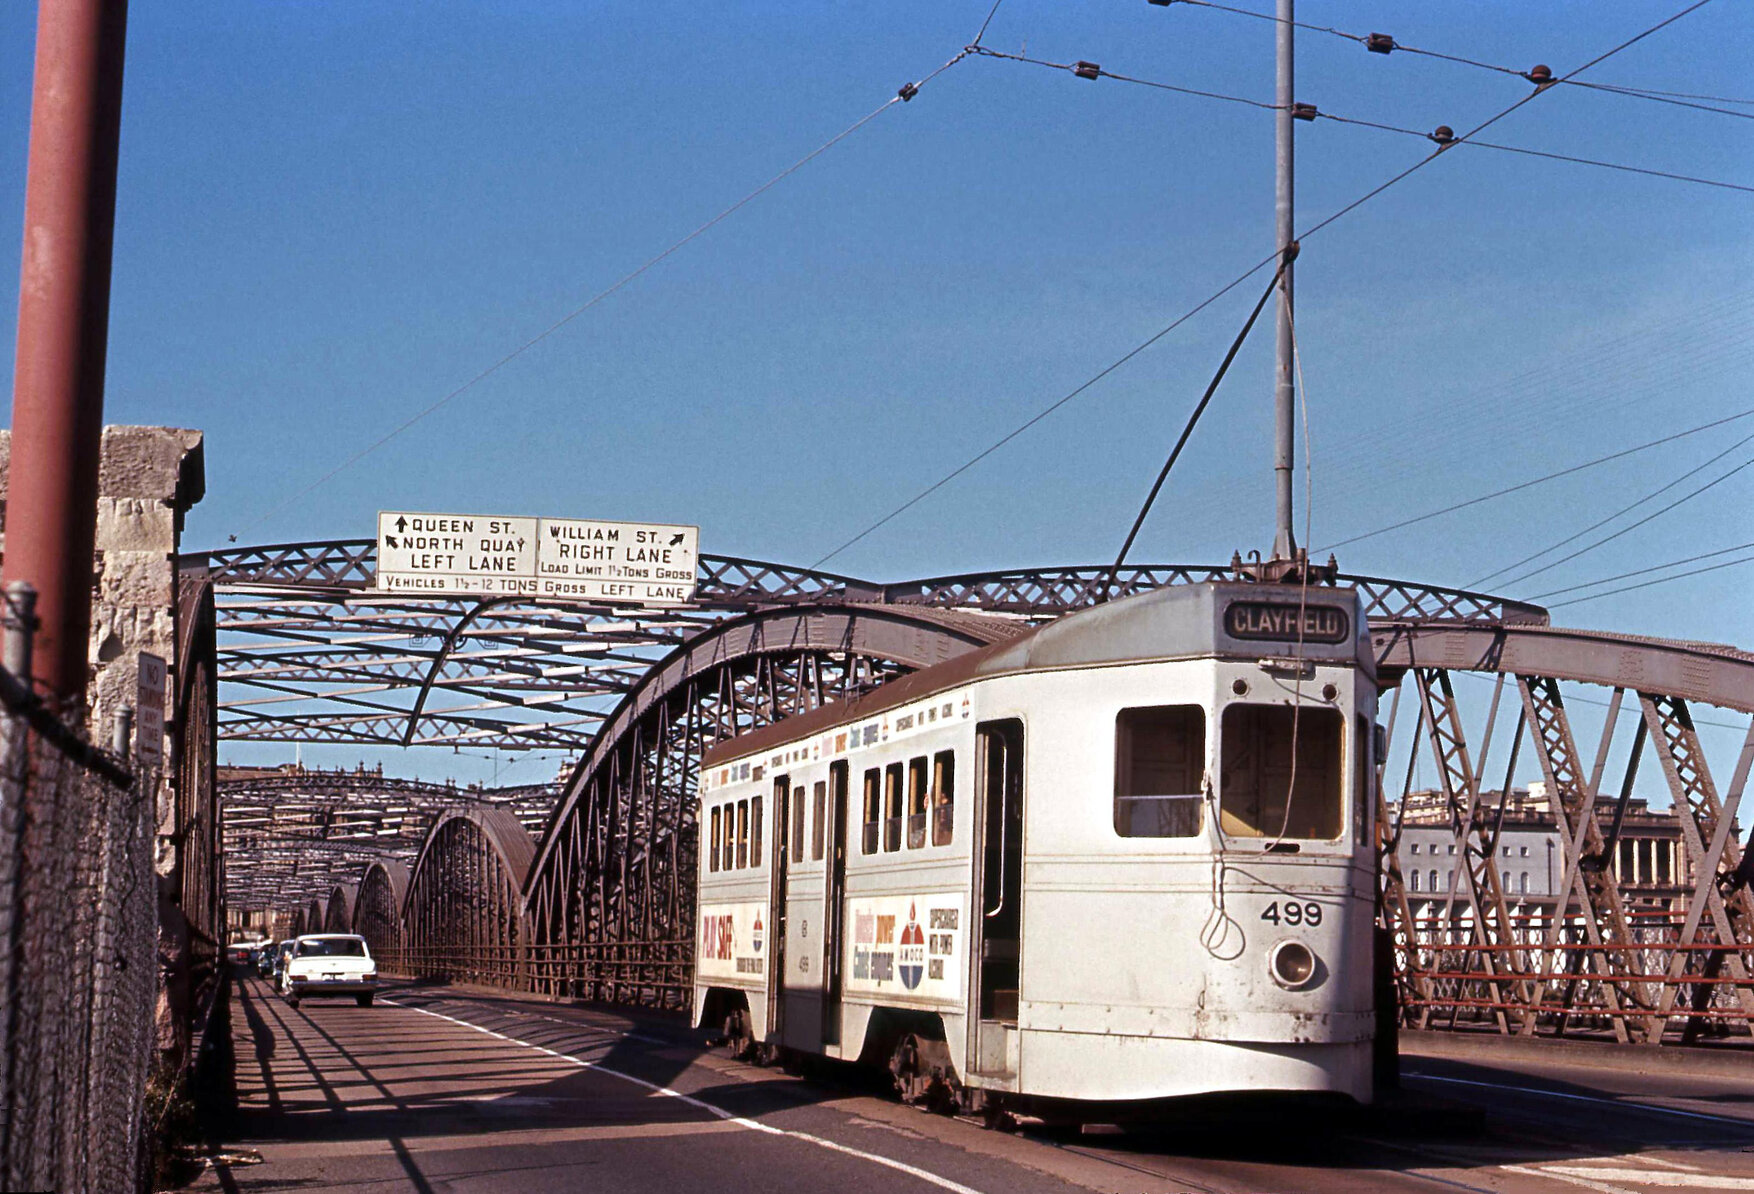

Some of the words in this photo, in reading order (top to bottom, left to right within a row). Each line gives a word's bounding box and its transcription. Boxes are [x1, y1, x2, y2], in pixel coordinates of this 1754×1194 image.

[412, 518, 474, 532] QUEEN
[489, 521, 516, 535] ST.
[550, 526, 619, 541] WILLIAM
[636, 531, 662, 544] ST.
[403, 537, 464, 551] NORTH
[480, 537, 526, 553] QUAY
[559, 544, 615, 560] RIGHT
[626, 547, 672, 563] LANE
[411, 554, 456, 569] LEFT
[469, 555, 517, 571] LANE
[500, 579, 538, 591] TONS
[601, 583, 635, 596] LEFT
[647, 586, 685, 599] LANE
[1234, 607, 1338, 635] CLAYFIELD
[1261, 901, 1323, 927] 499
